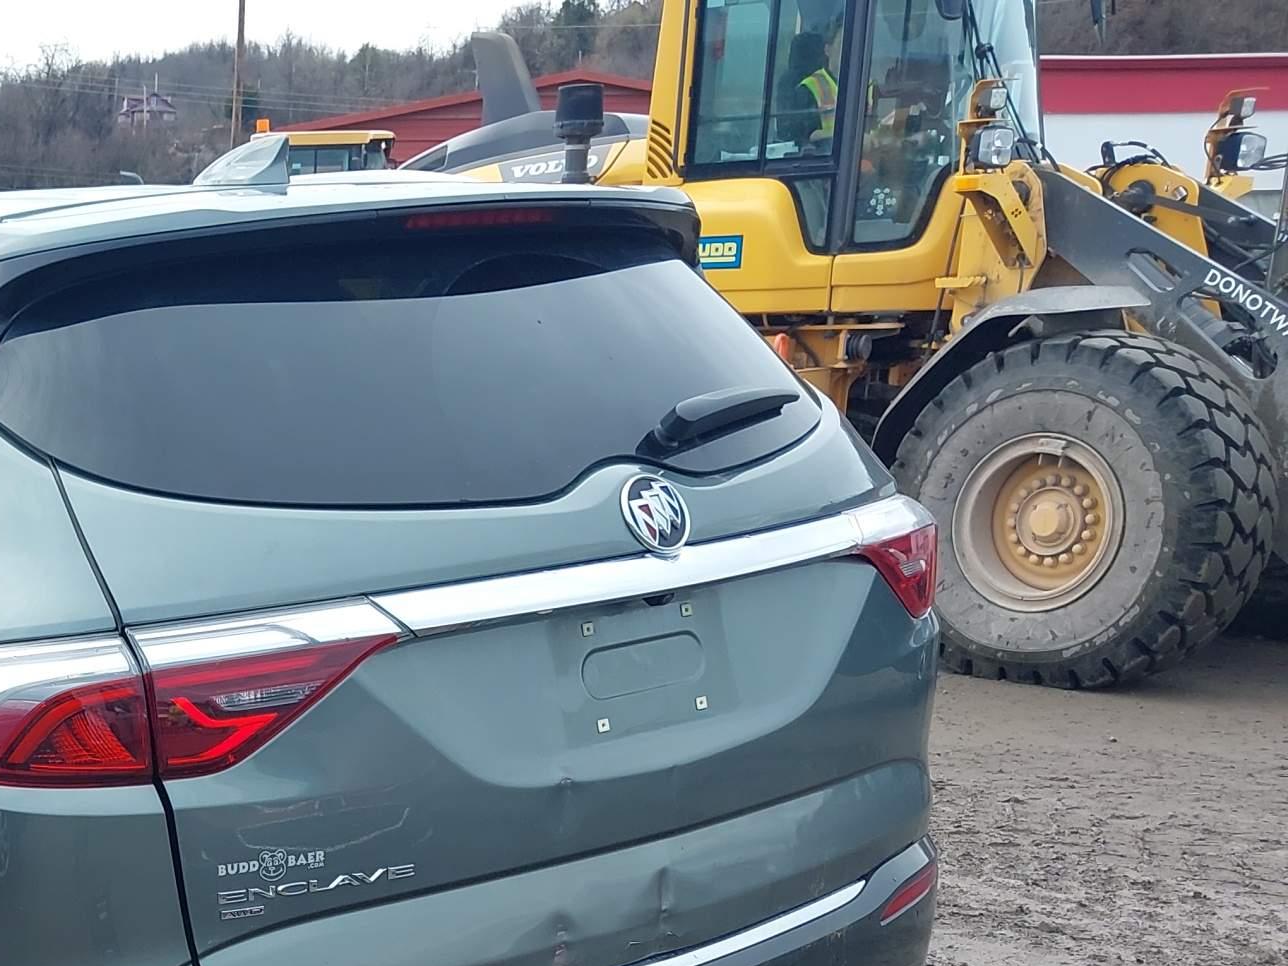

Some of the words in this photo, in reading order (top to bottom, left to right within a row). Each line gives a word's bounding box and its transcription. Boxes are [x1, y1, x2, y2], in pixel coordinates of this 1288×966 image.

[511, 153, 599, 178] VOLO
[698, 242, 737, 257] UDD
[217, 860, 259, 876] BUDD
[287, 850, 326, 867] BAER
[217, 863, 416, 904] ENCLAVE
[221, 906, 265, 920] AWD
